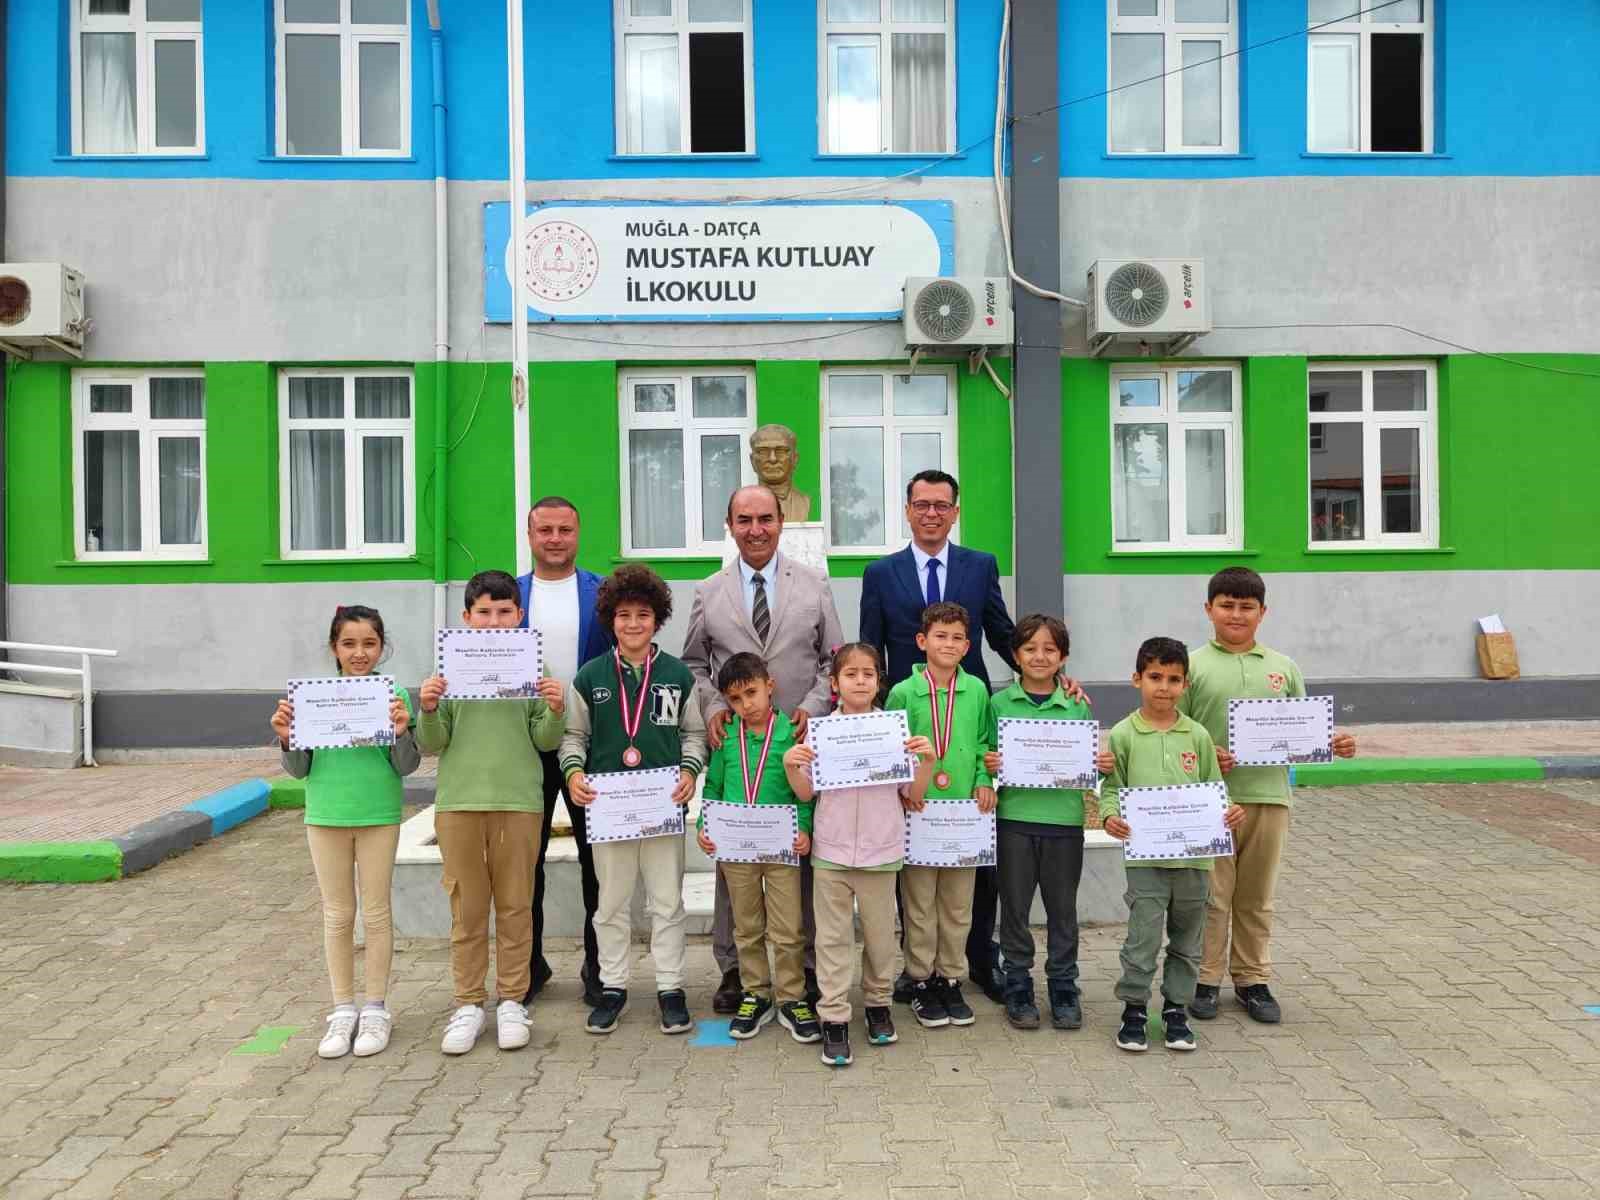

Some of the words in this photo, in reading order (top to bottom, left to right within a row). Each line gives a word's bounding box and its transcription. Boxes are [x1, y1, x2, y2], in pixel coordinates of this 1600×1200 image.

[625, 219, 690, 237] MUĞLA
[704, 221, 761, 240] DATÇA
[626, 246, 750, 269] MUSTAFA
[757, 245, 876, 268] KUTLUAY
[626, 276, 757, 302] İLKOKULU
[650, 683, 682, 726] N
